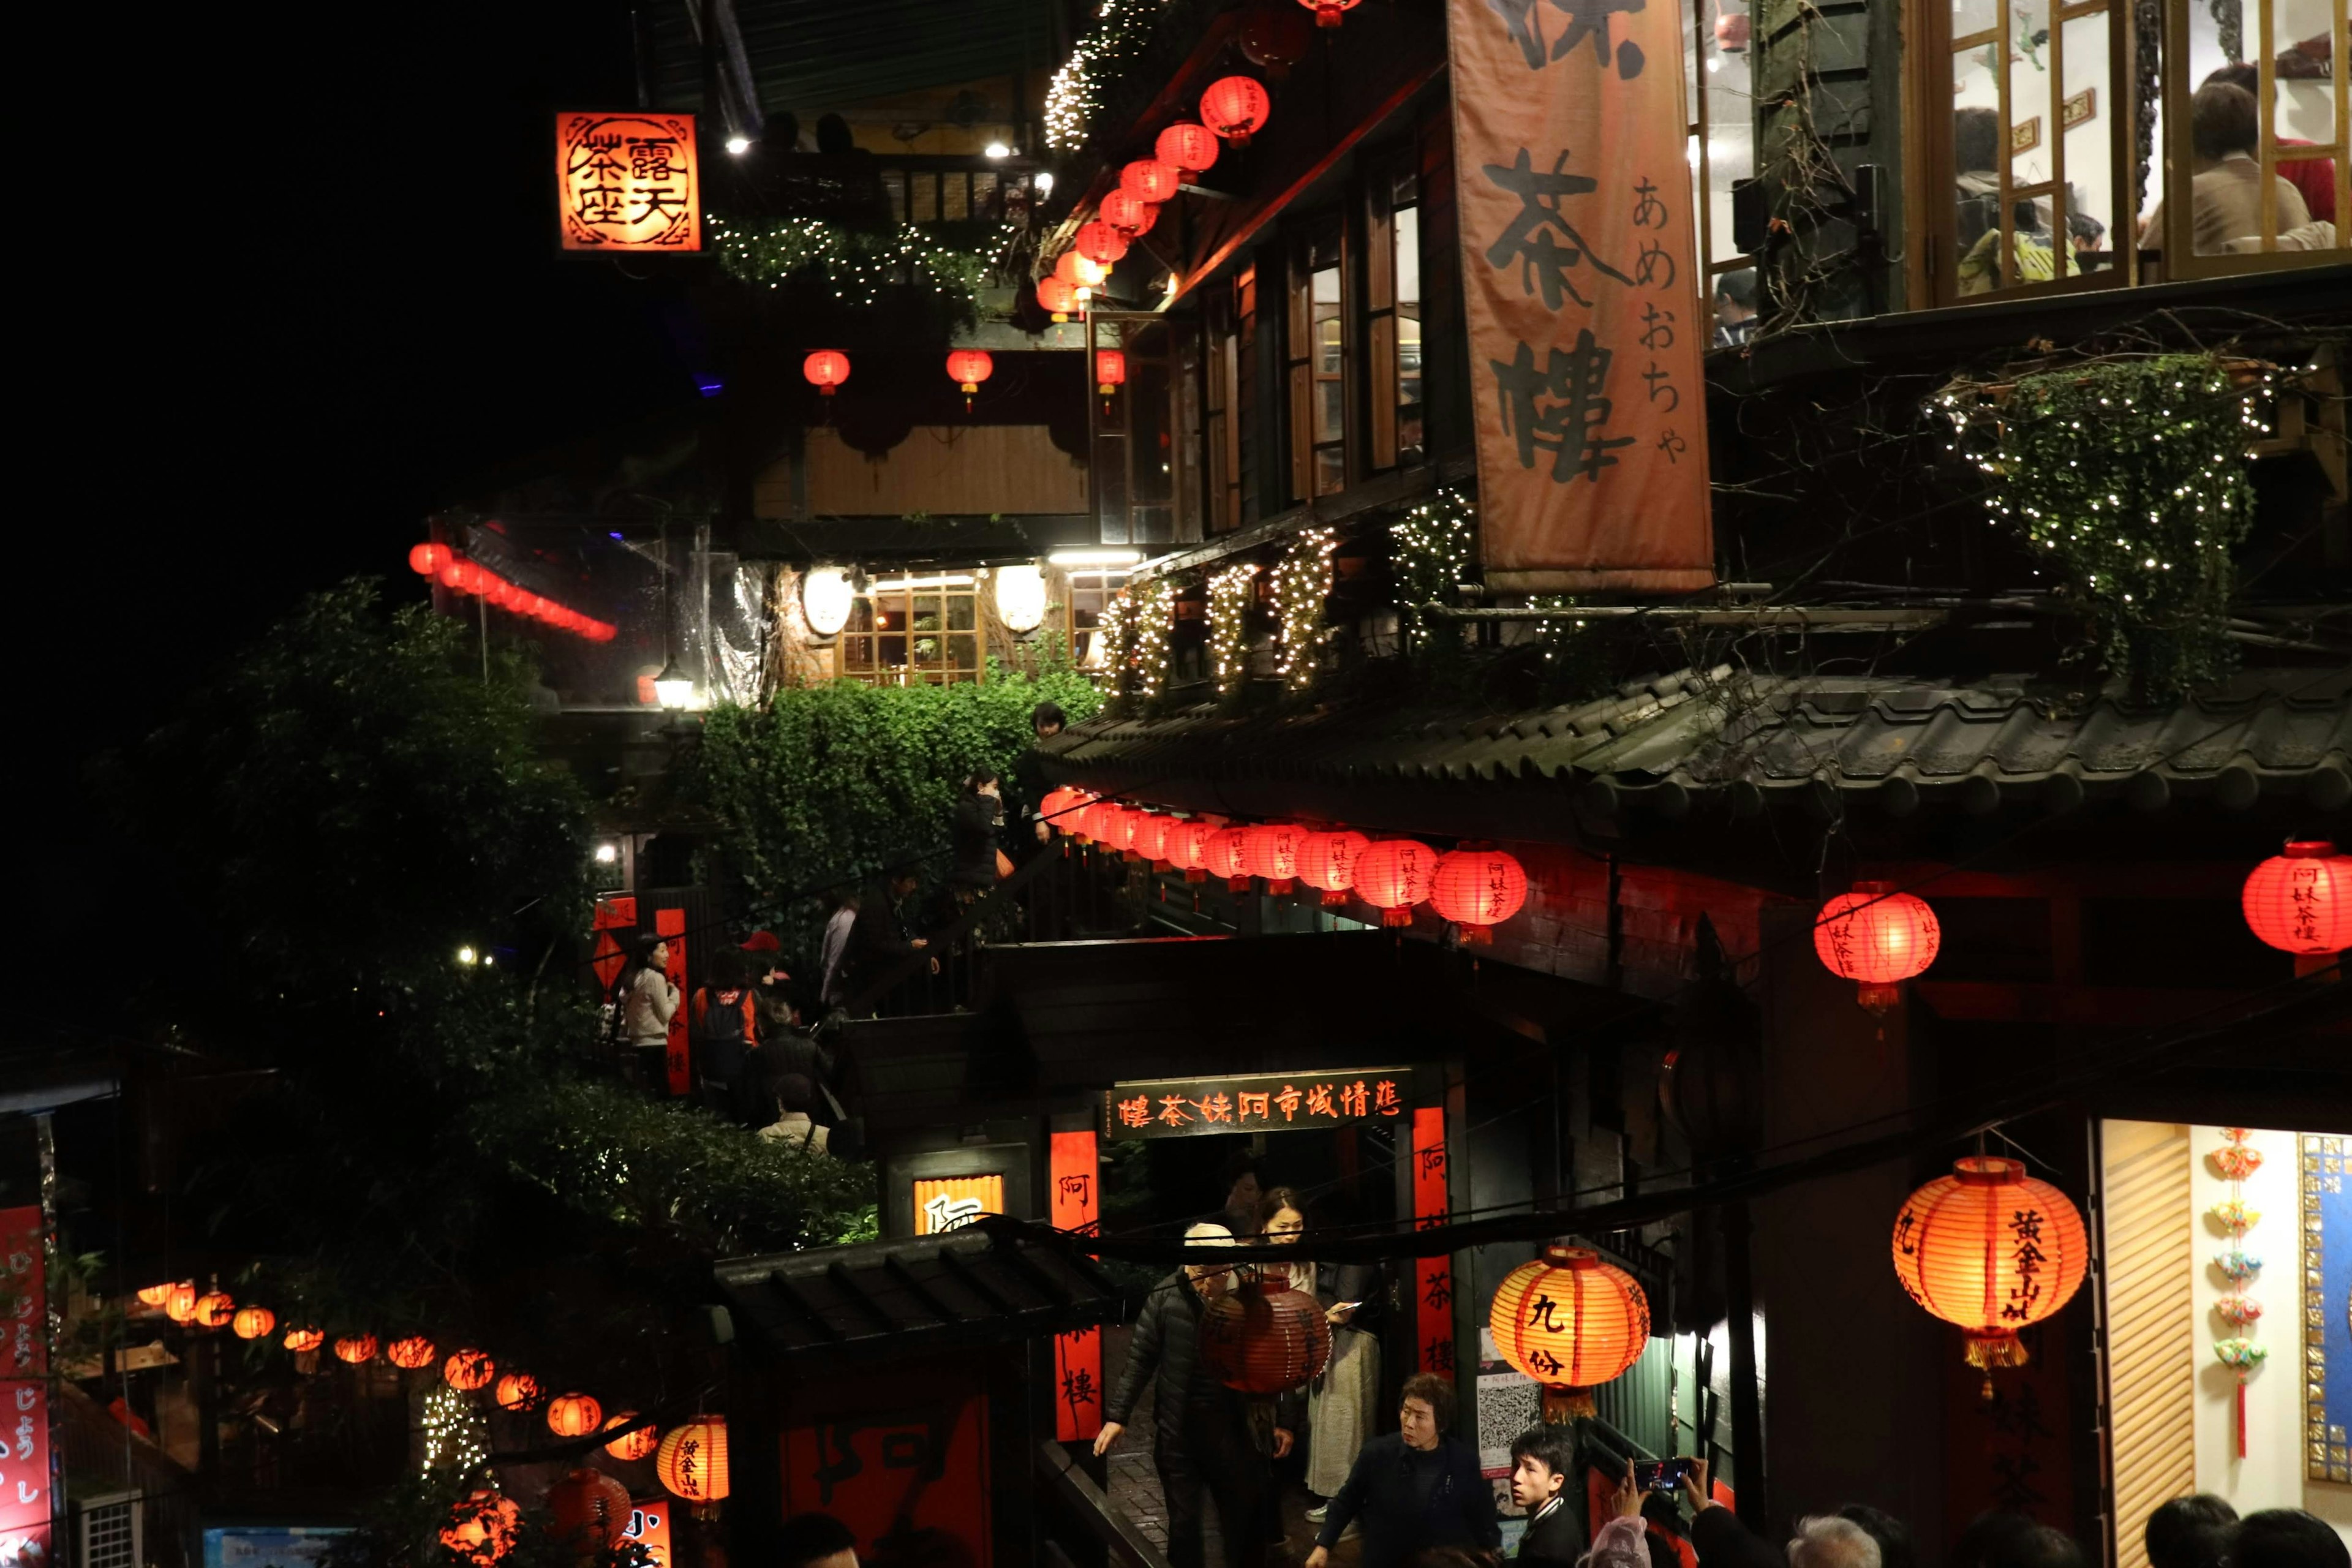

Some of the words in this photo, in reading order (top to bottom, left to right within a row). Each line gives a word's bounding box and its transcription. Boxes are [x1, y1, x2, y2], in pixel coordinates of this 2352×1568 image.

[568, 133, 627, 225] 茶座
[626, 136, 687, 224] 露天
[1632, 176, 1686, 464] あめおちゃ
[2290, 867, 2323, 942] 阿妹茶樓
[1527, 1294, 1565, 1377] 九份
